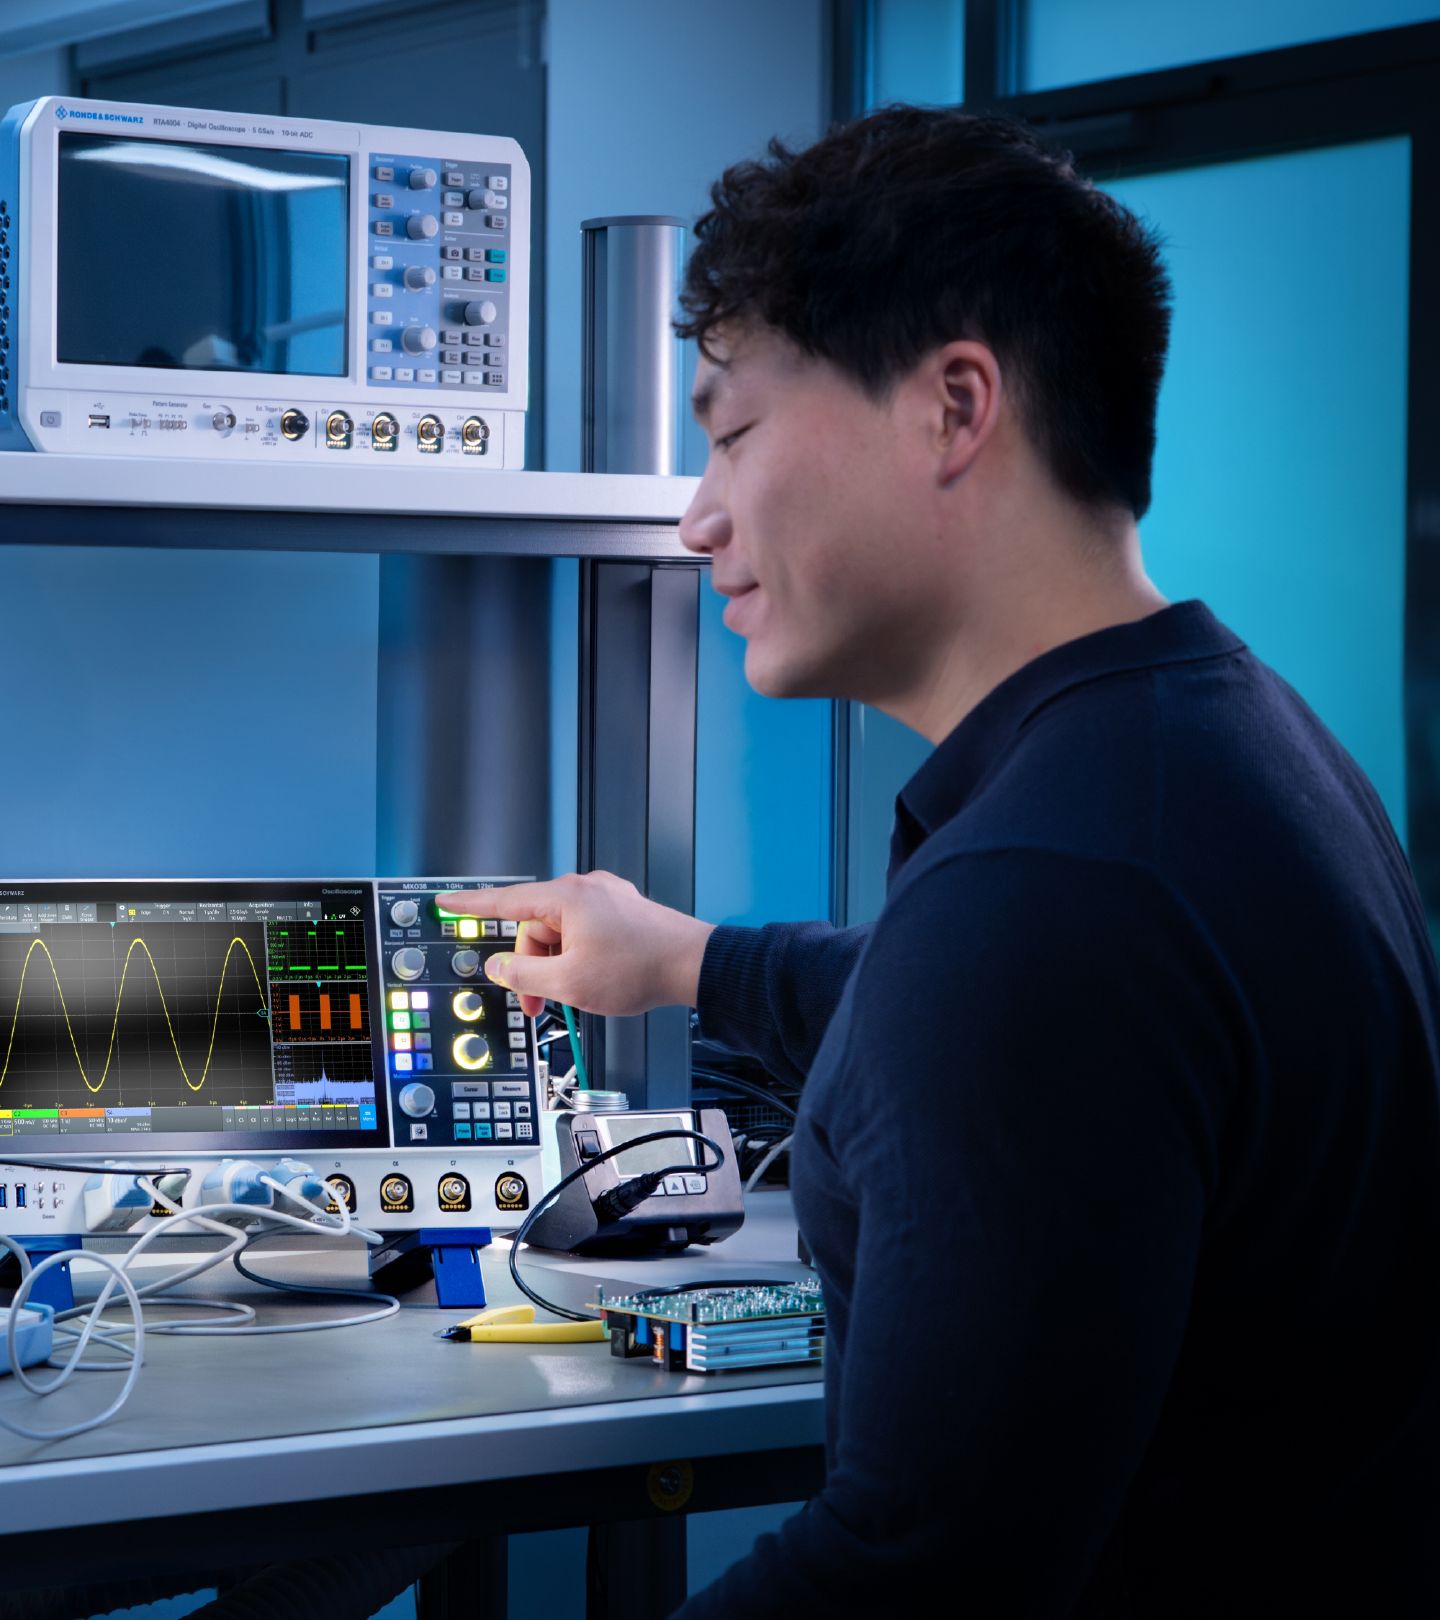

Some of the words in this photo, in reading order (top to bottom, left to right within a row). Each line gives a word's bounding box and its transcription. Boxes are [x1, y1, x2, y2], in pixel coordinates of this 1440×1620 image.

[69, 110, 144, 124] ROHDE&SCHWARZ
[153, 118, 181, 127] RTA4004
[187, 121, 207, 131] Digital
[208, 123, 246, 133] Oscilloscope
[322, 888, 363, 896] Oscilloscope
